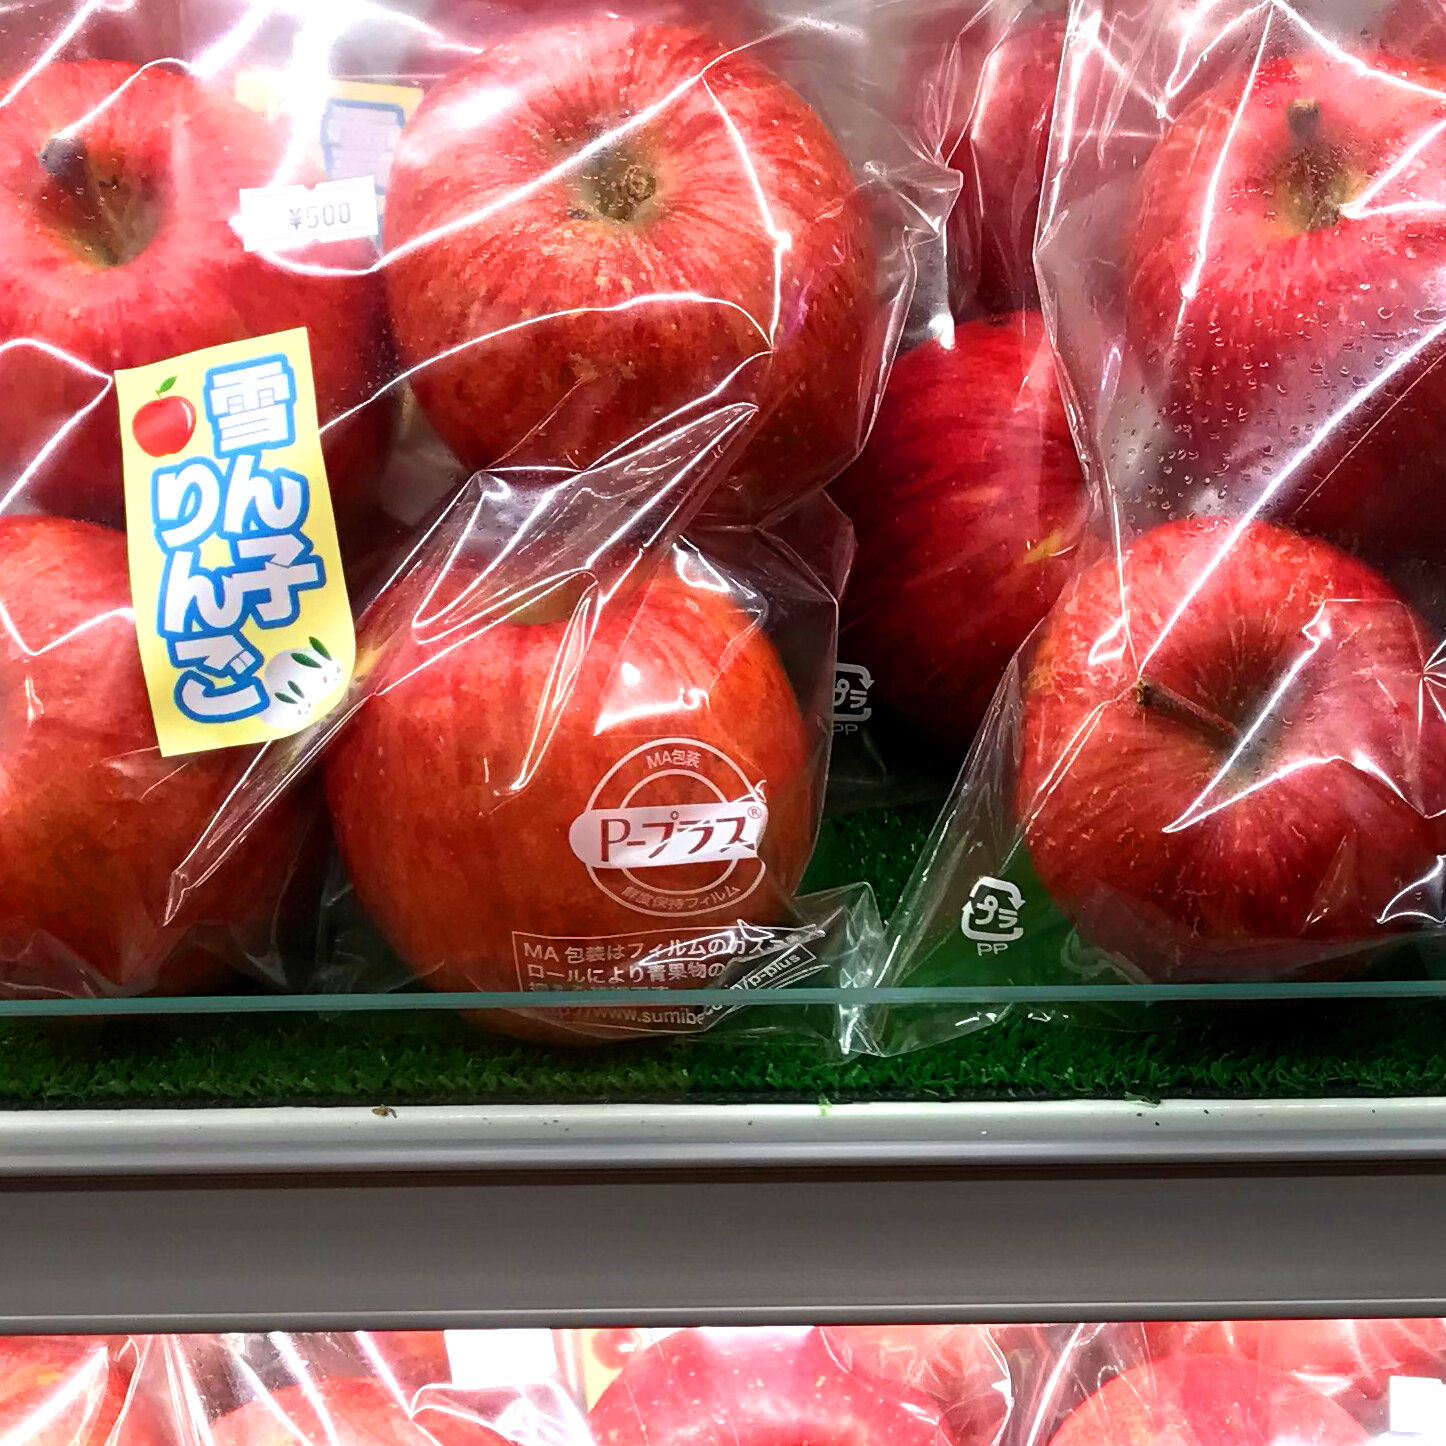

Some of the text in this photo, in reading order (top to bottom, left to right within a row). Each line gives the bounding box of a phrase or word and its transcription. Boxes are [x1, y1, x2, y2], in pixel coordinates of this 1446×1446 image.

[289, 202, 352, 230] ¥500
[204, 353, 326, 629] 雪ん子
[151, 456, 270, 723] りんご
[645, 749, 702, 770] MA包装
[976, 942, 1009, 956] PP
